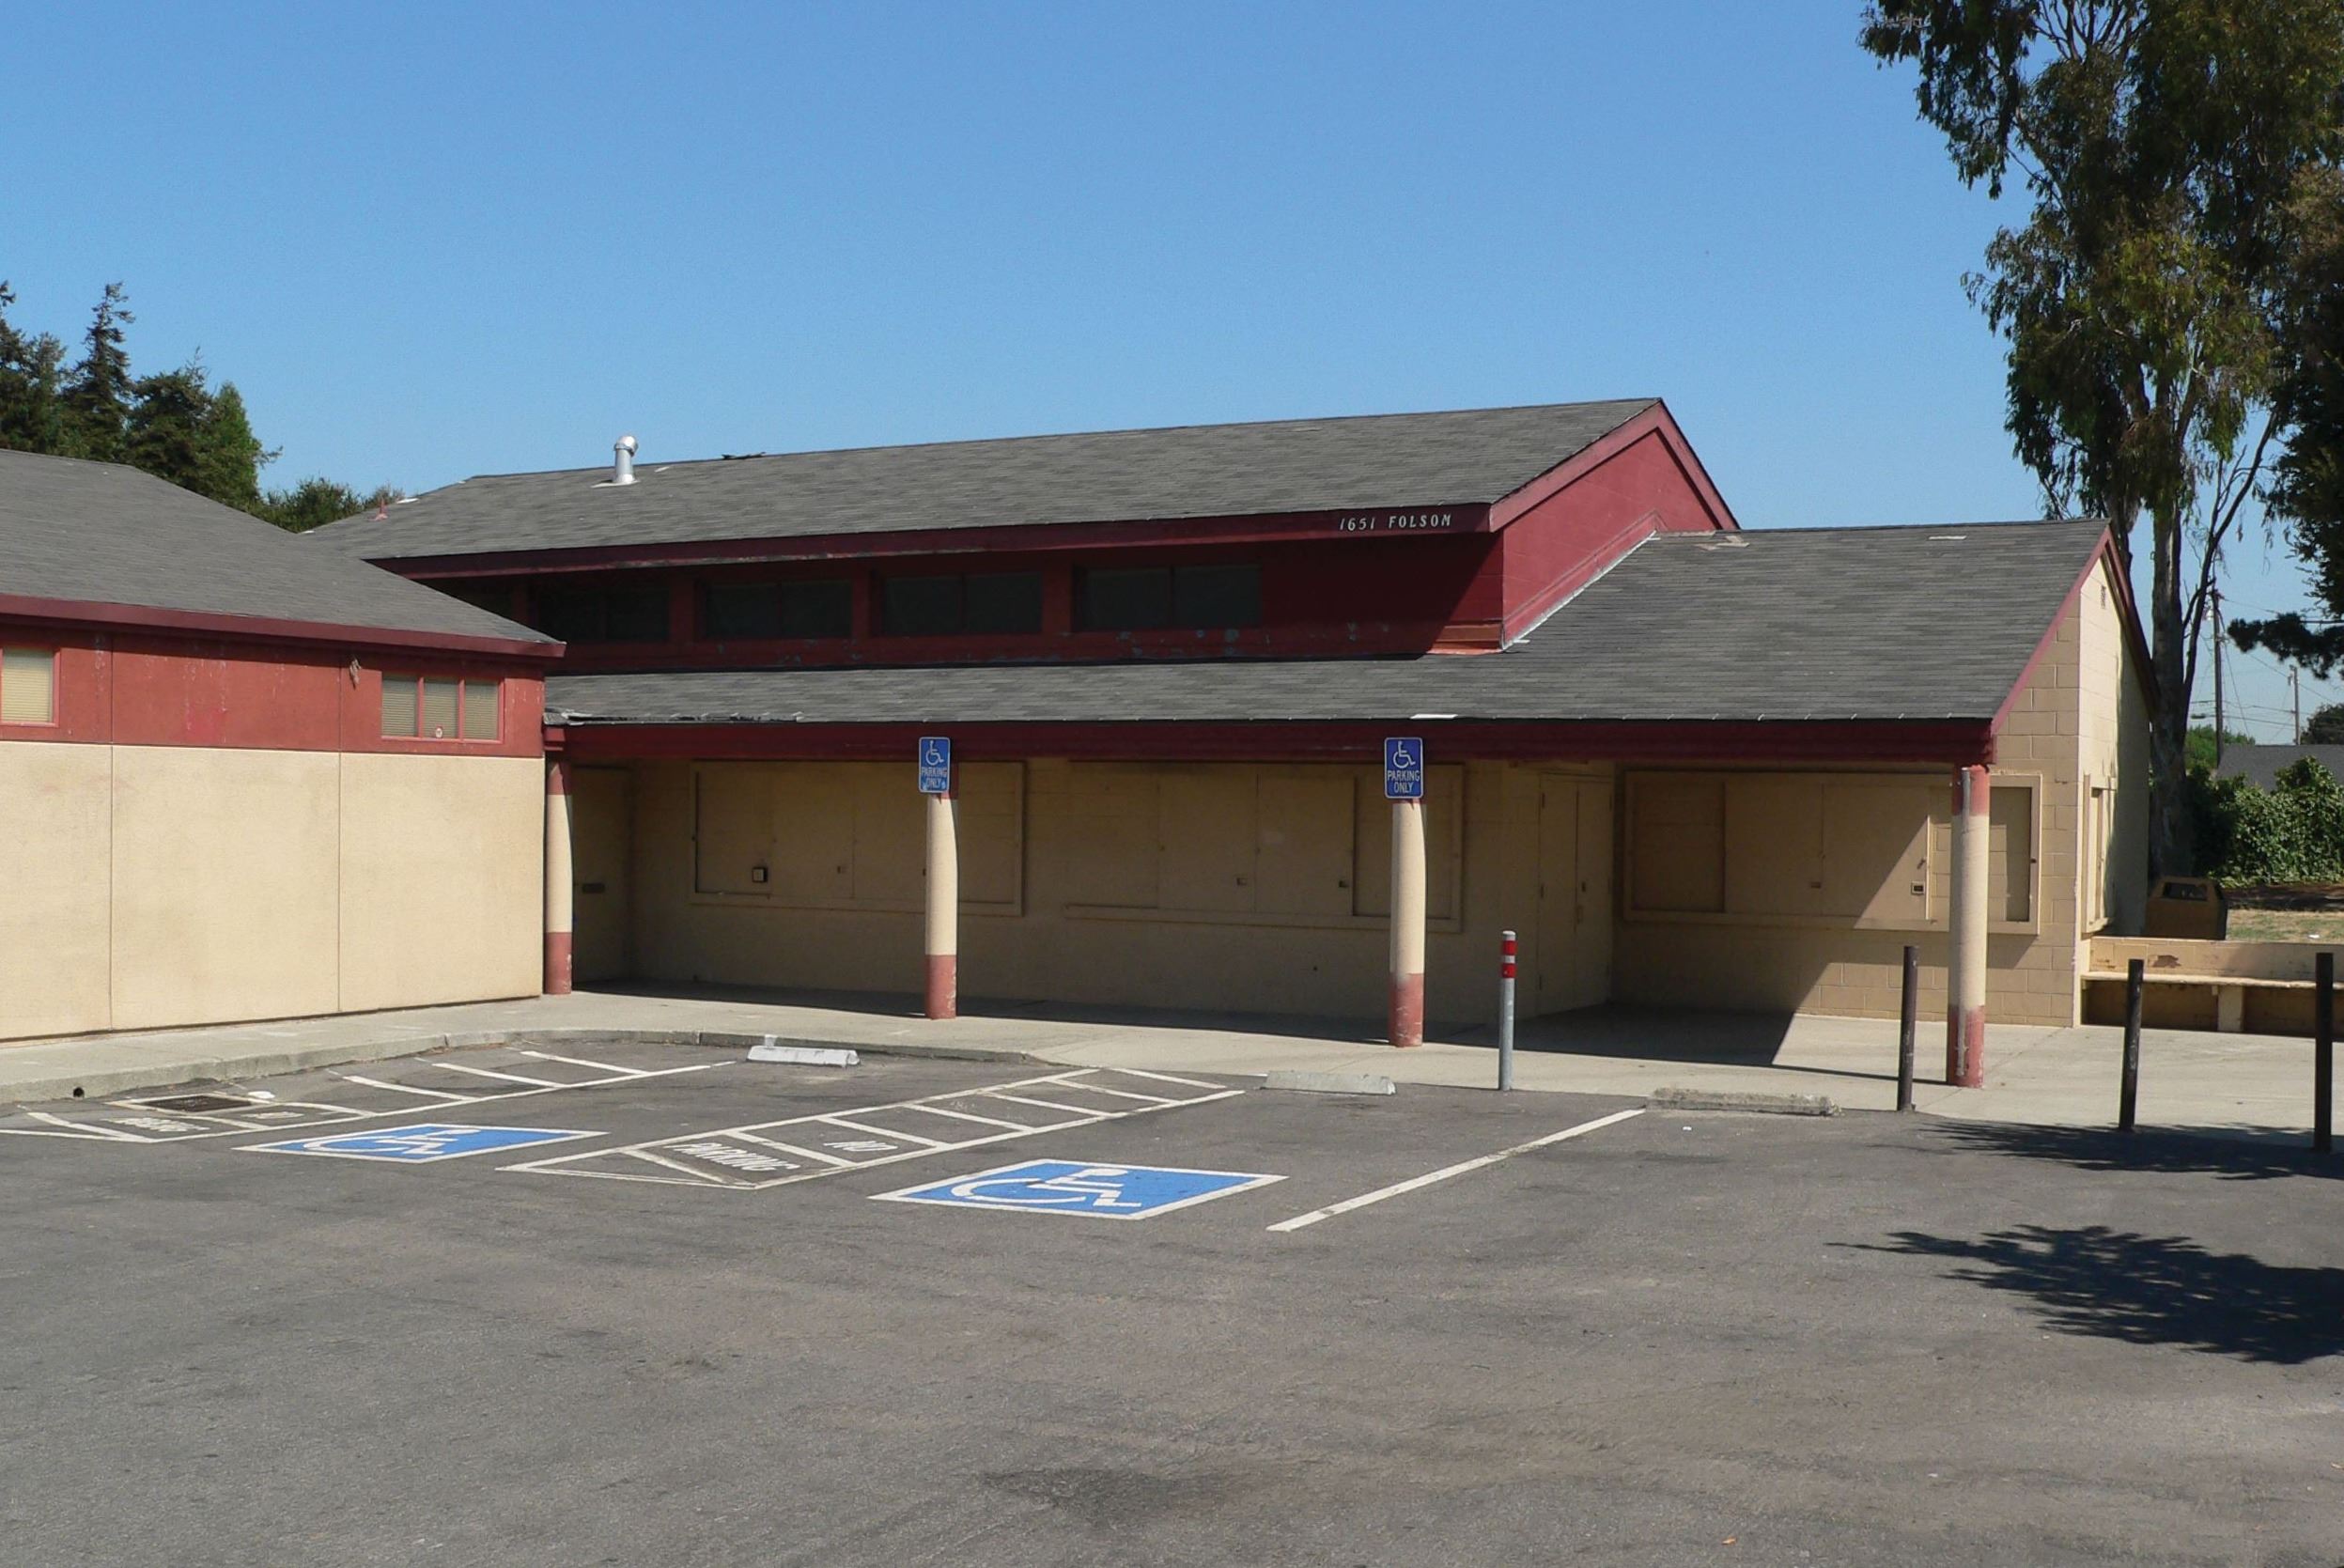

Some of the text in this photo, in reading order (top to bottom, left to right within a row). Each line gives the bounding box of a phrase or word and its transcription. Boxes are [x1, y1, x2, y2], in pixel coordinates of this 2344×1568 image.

[1340, 513, 1451, 531] 1651 FOLSOM
[921, 767, 948, 777] PARKING
[1388, 769, 1420, 781] PARKING
[926, 778, 942, 788] ONLY
[1394, 782, 1414, 793] ONLY
[823, 1140, 898, 1152] NO
[662, 1141, 800, 1172] PARKING
